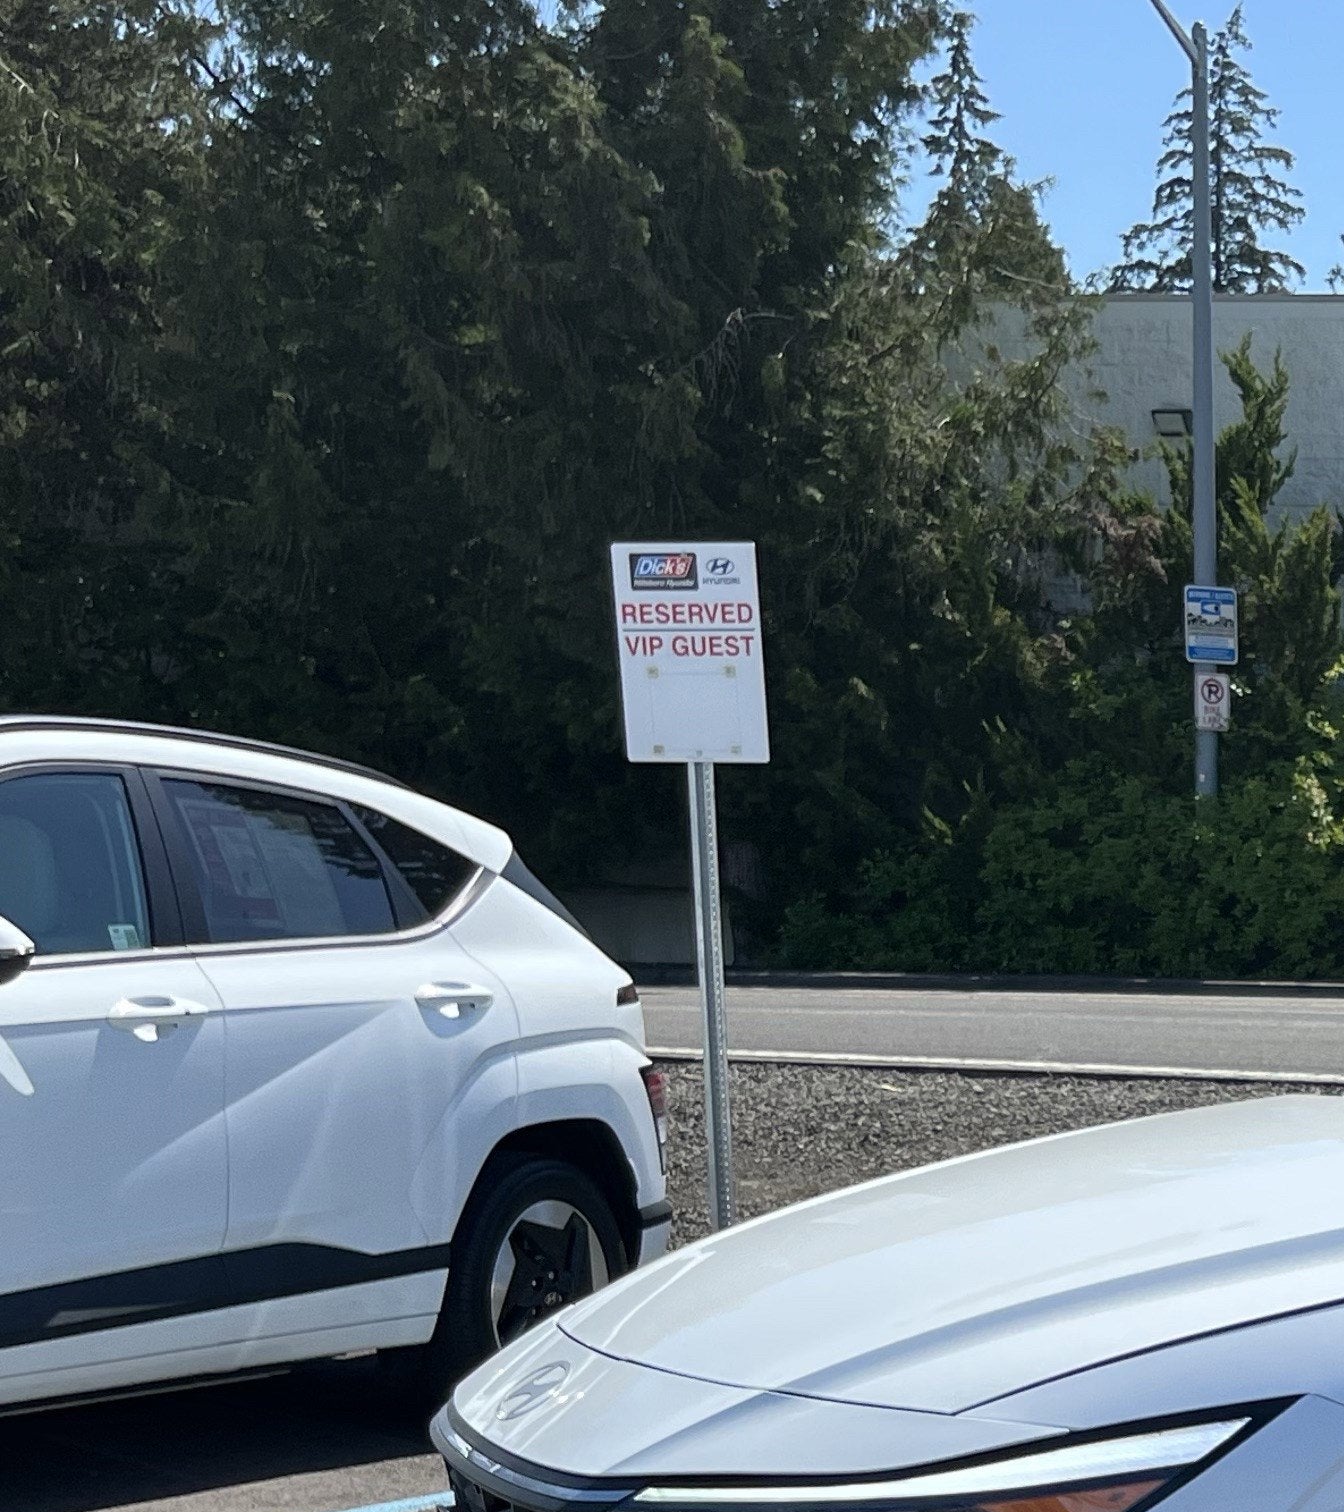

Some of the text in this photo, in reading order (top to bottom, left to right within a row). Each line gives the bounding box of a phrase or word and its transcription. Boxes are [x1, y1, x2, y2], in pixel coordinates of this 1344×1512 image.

[622, 603, 753, 624] RESERVED
[626, 636, 755, 656] VIP GUEST
